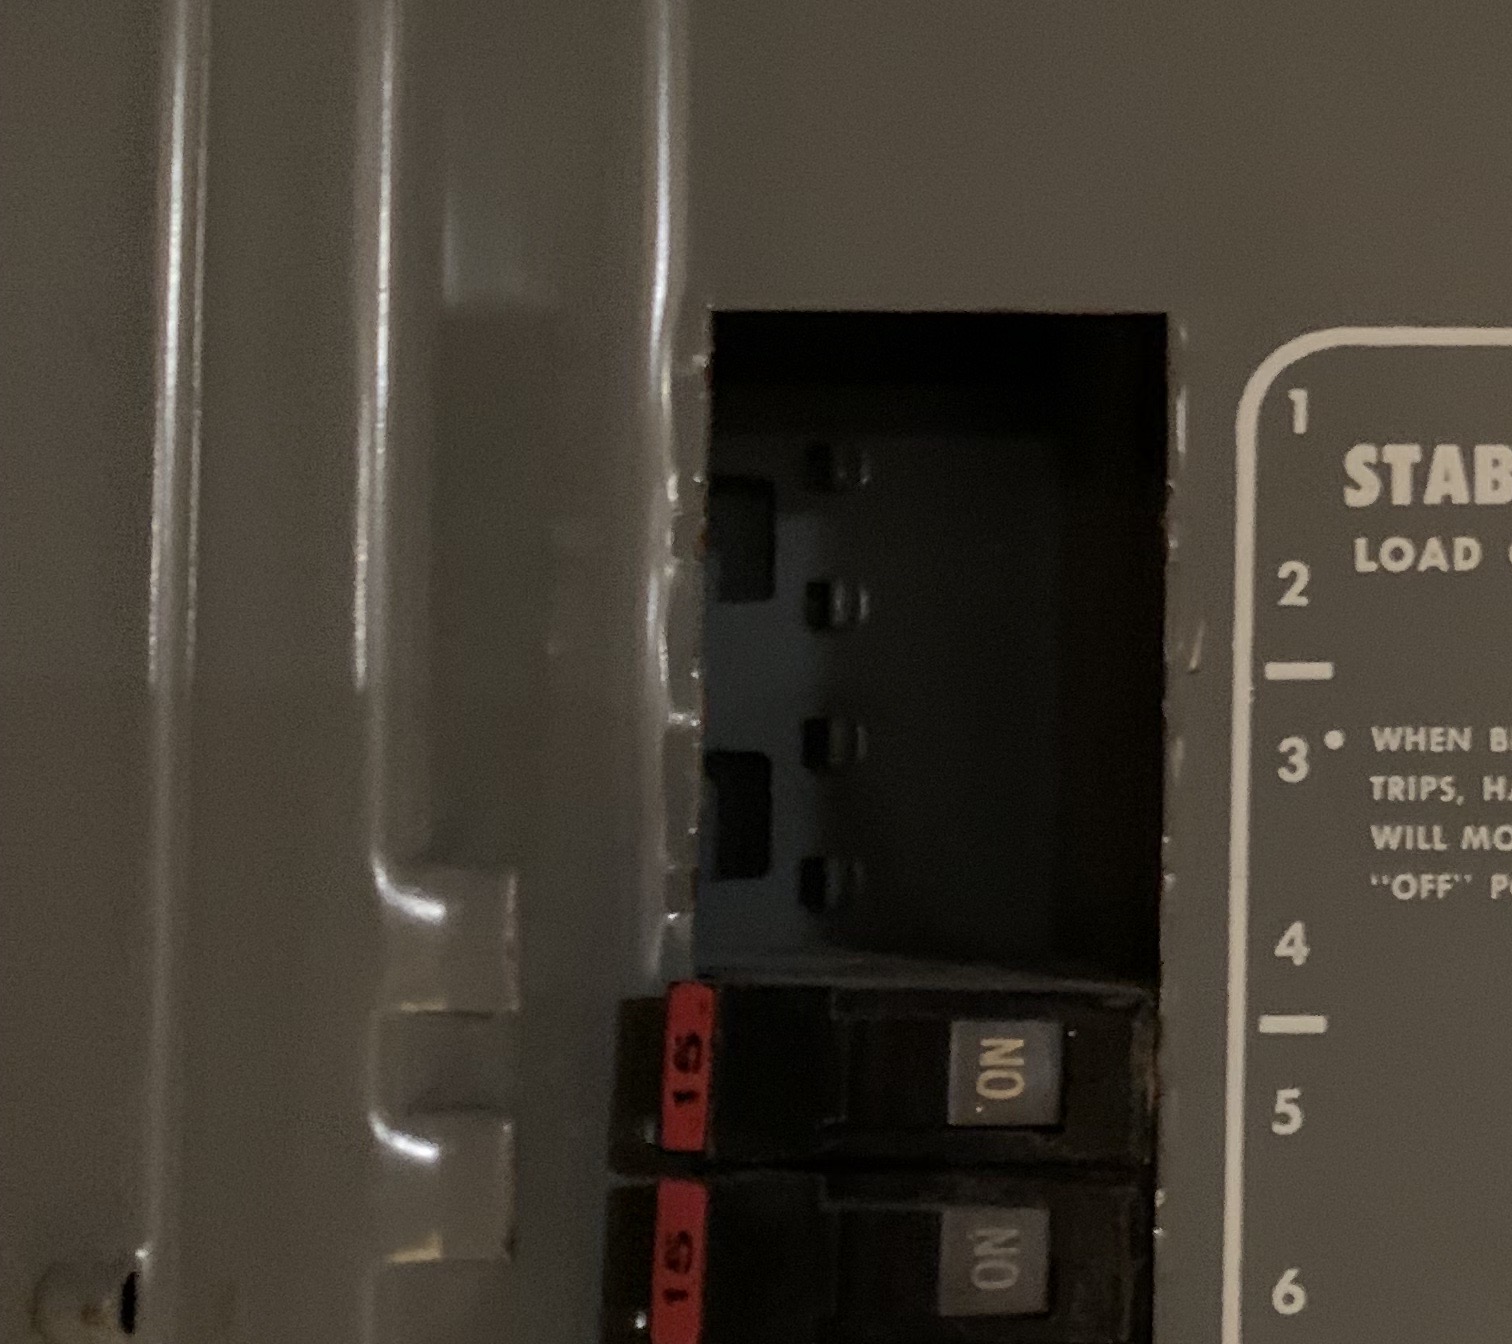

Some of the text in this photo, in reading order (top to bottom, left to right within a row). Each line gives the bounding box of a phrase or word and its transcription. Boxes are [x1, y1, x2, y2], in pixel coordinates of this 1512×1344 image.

[1288, 388, 1308, 434] 1
[1354, 537, 1482, 573] LOAD
[1277, 561, 1310, 606] 2
[1277, 737, 1310, 783] 3
[1371, 727, 1472, 751] WHEN
[1370, 777, 1466, 805] TRIPS,
[1371, 825, 1448, 850] WILL
[1274, 921, 1310, 965] 4
[673, 1033, 702, 1104] 15
[975, 1038, 1024, 1100] ON
[1271, 1088, 1302, 1135] 5
[663, 1230, 694, 1305] 15
[971, 1227, 1020, 1291] ON
[1272, 1268, 1306, 1314] 6
